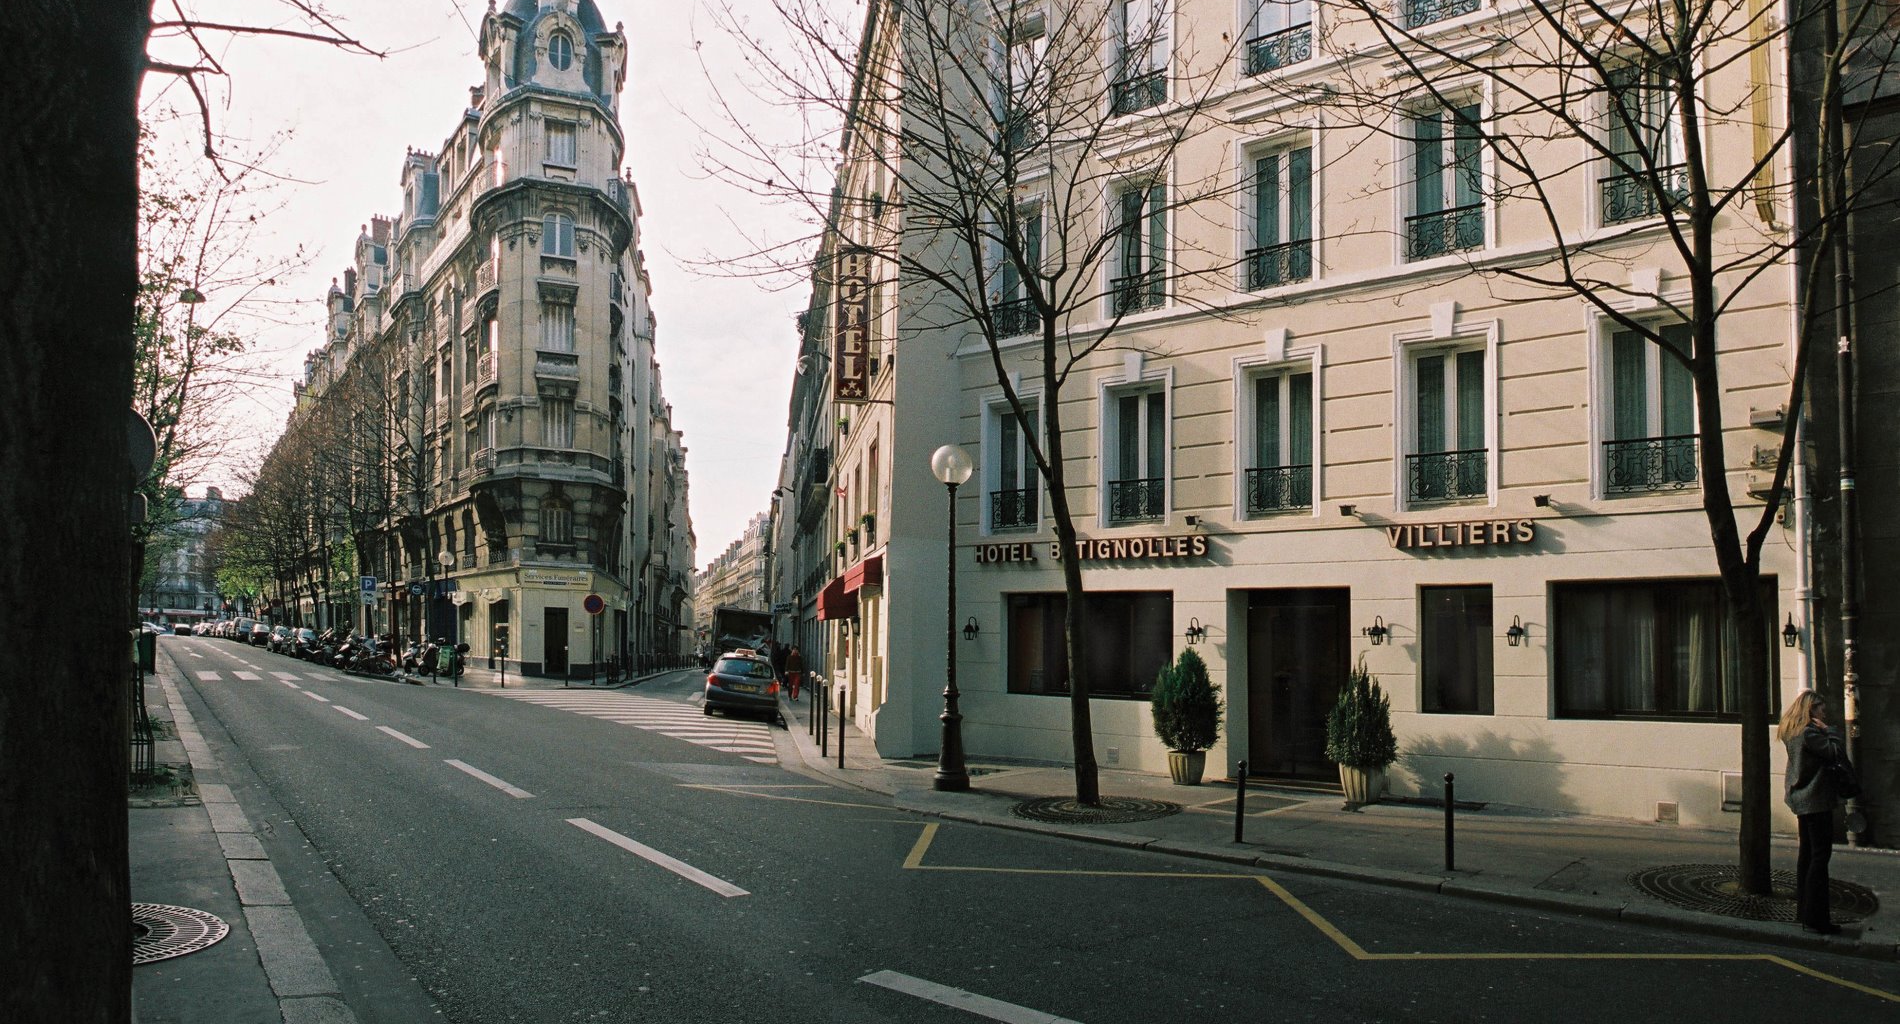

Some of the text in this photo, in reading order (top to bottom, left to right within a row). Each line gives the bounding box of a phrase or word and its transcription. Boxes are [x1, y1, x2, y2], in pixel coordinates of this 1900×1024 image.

[840, 253, 868, 380] HOTEL
[1385, 518, 1535, 548] VILLIERS
[975, 535, 1207, 563] HOTEL BTIGNOLLES
